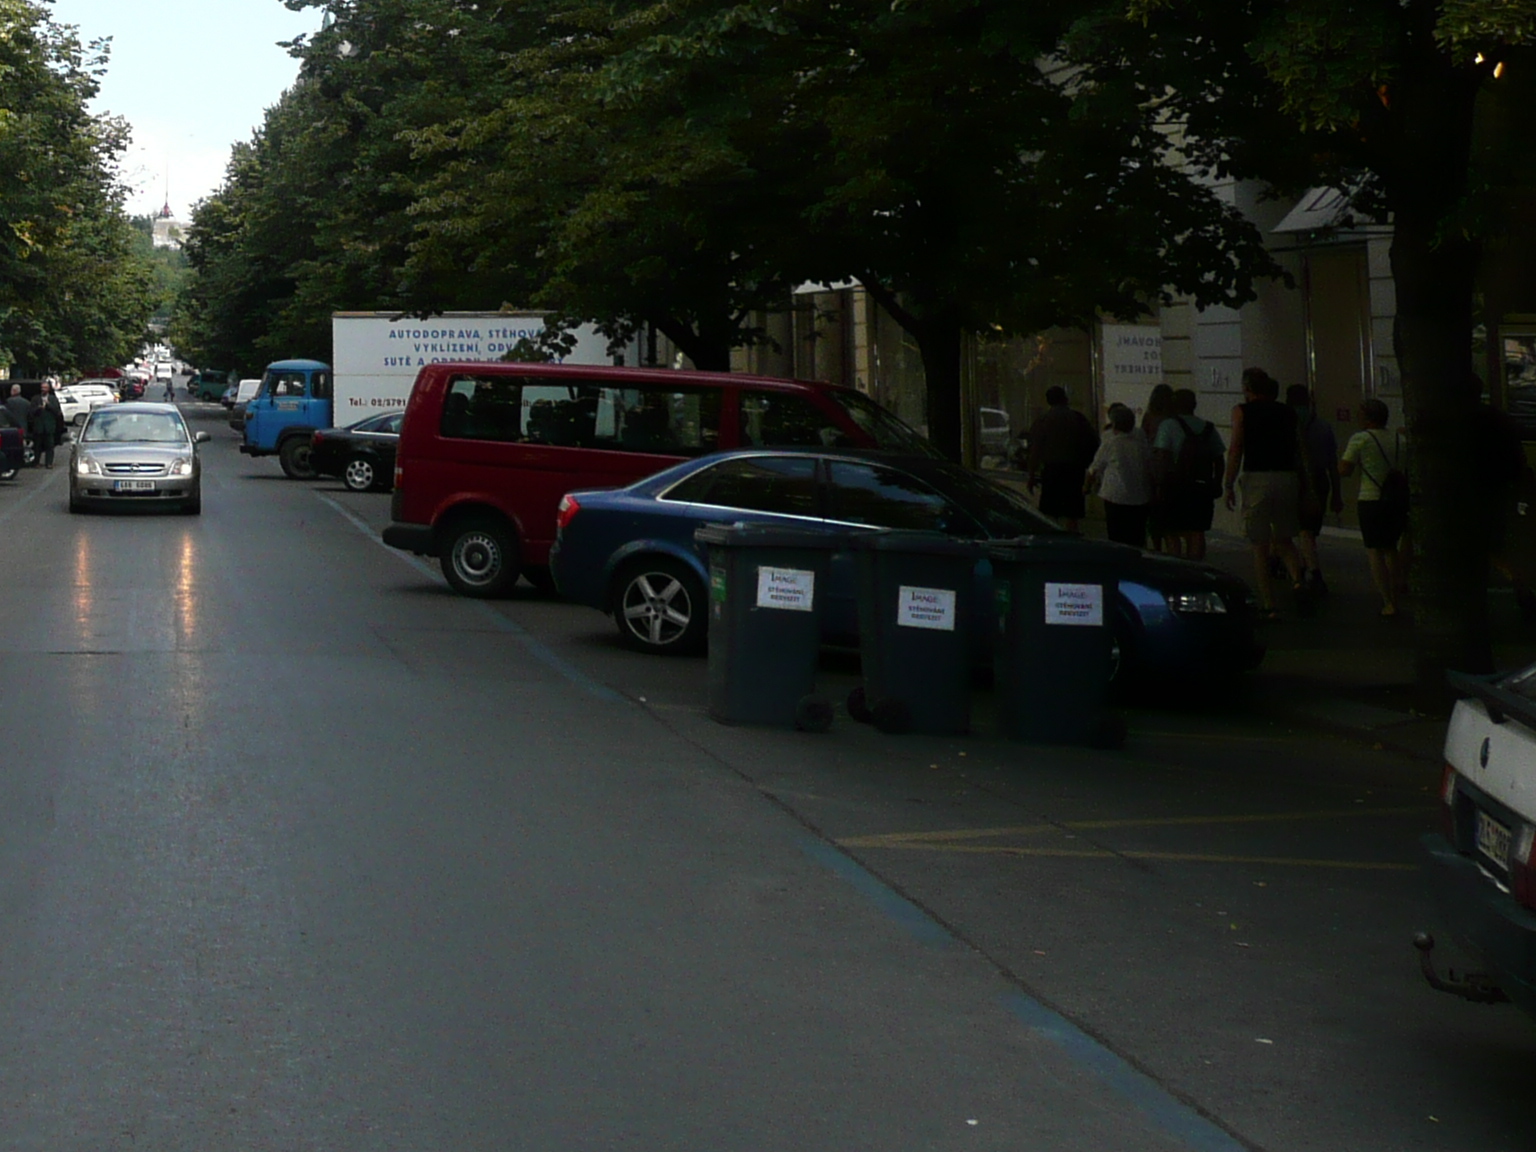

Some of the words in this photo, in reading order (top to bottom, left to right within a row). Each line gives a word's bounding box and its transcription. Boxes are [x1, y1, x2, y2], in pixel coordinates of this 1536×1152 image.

[487, 342, 514, 353] ODV
[384, 355, 412, 367] SUTĚ
[417, 356, 425, 366] A
